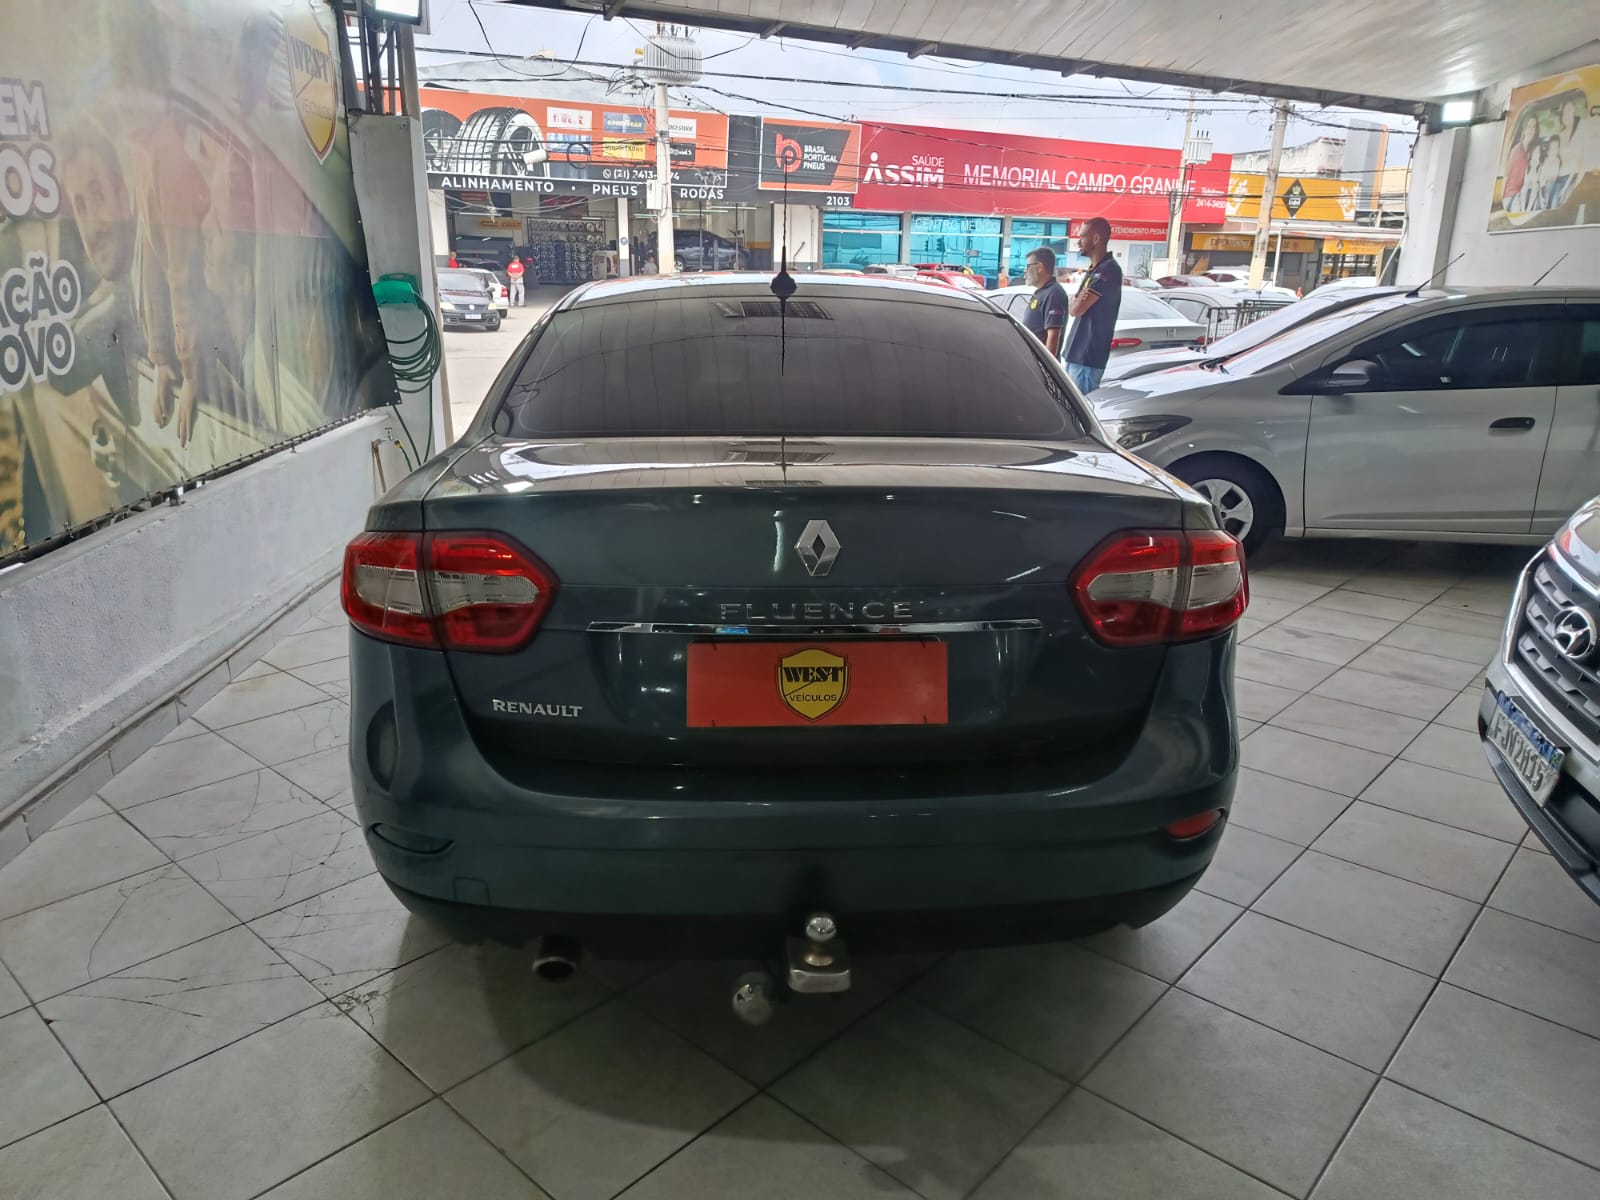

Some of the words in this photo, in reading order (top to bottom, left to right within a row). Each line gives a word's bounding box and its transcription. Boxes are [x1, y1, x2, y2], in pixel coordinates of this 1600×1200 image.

[804, 145, 826, 154] BRASIL
[803, 154, 838, 163] PORTUGAL
[911, 154, 944, 167] SAÚDE
[803, 161, 826, 170] PNEUS
[613, 168, 630, 180] (21)
[963, 163, 1061, 190] MEMORIAL
[1065, 170, 1126, 193] CAMPO
[441, 177, 554, 193] ALINHAMENTO
[592, 183, 638, 196] PNEUS
[680, 187, 724, 200] RODAS
[826, 195, 850, 206] 2103
[720, 602, 913, 620] FLUENCE
[784, 666, 844, 683] WEST
[789, 693, 837, 702] VEÍCULOS
[492, 699, 583, 717] RENAULT
